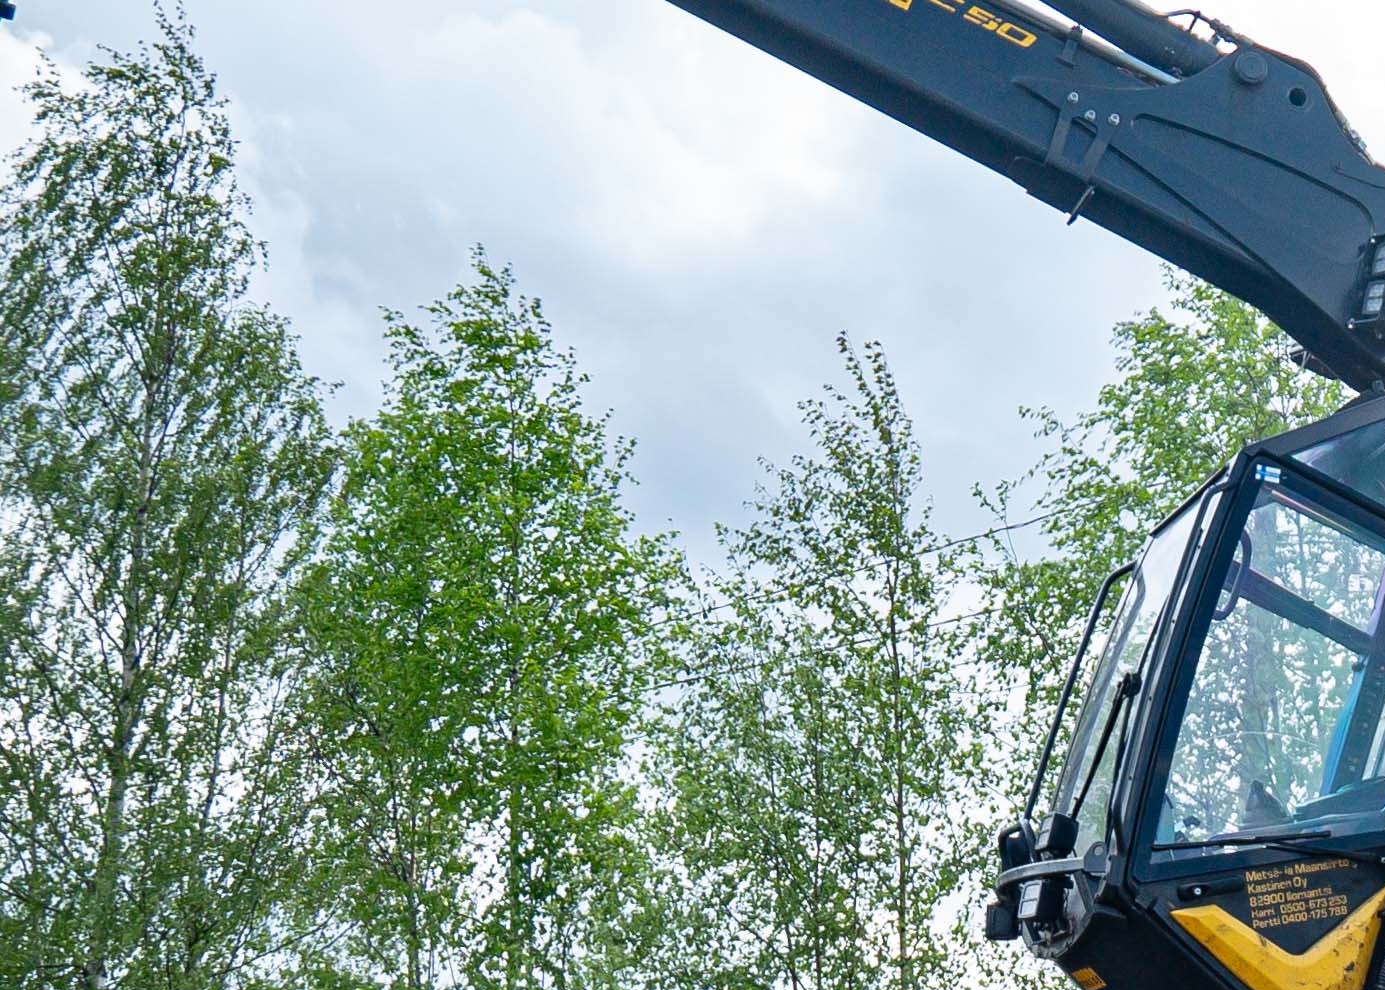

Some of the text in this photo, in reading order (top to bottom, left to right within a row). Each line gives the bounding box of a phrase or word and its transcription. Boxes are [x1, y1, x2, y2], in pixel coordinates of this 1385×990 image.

[1292, 876, 1308, 889] Oy
[1249, 892, 1285, 907] 82900
[1252, 917, 1281, 930] Pertti
[1281, 909, 1328, 925] 0400-175
